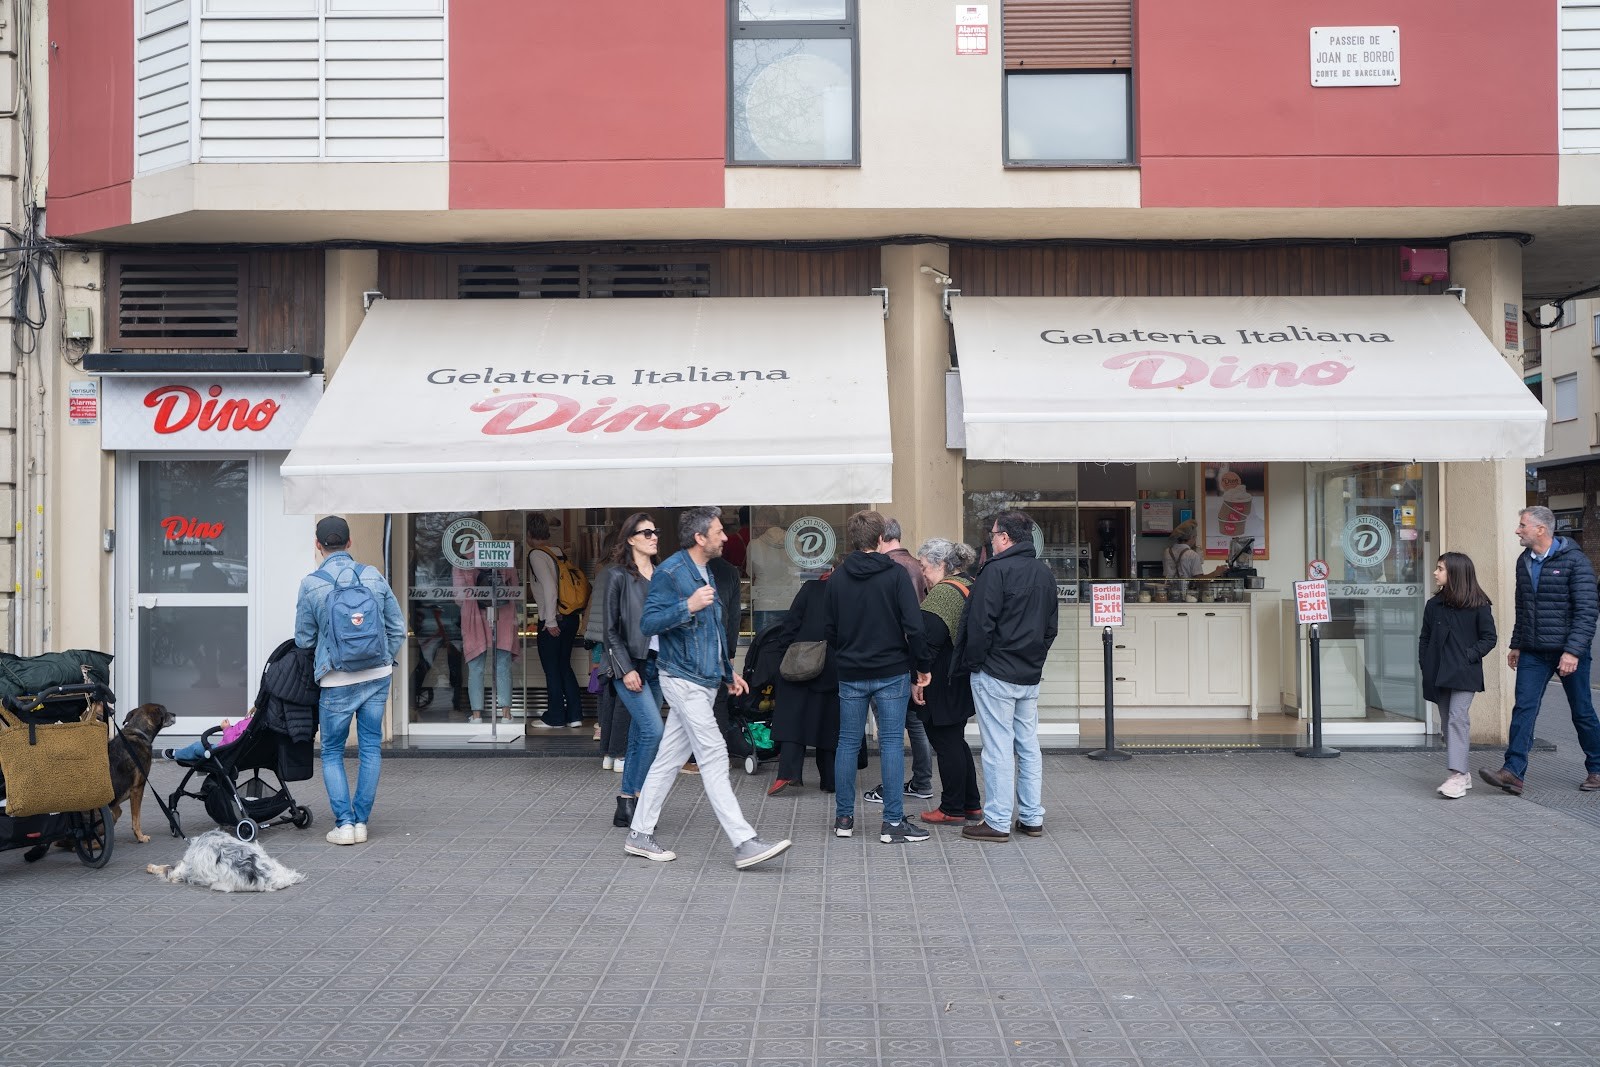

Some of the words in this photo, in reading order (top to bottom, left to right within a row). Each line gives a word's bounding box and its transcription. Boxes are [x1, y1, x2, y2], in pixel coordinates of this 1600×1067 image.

[958, 26, 986, 34] Alarma
[1329, 36, 1365, 45] PASSEIG
[1369, 36, 1380, 44] DE
[1316, 52, 1341, 63] JOAN
[1347, 54, 1358, 63] DE
[1363, 48, 1394, 62] BORBÓ
[1040, 328, 1226, 345] Gelateria
[1236, 326, 1395, 344] Italiana
[427, 368, 616, 386] Gelateria
[632, 366, 791, 385] Italiana
[1102, 350, 1356, 390] Dino
[143, 384, 280, 434] Dino
[470, 392, 730, 436] Dino
[160, 515, 224, 540] Dino
[450, 522, 469, 534] GELATI
[471, 523, 485, 534] DINO
[792, 520, 812, 532] GELATI
[814, 521, 828, 532] DINO
[1347, 518, 1368, 530] GELATI
[1369, 518, 1384, 530] DINO
[478, 550, 510, 560] ENTRY
[432, 588, 457, 598] Dino
[463, 588, 490, 598] Dino
[496, 588, 521, 597] Dino
[1342, 586, 1369, 596] Dino
[1374, 586, 1400, 596] Dino
[1095, 602, 1121, 613] Exit
[1299, 600, 1327, 611] Exit
